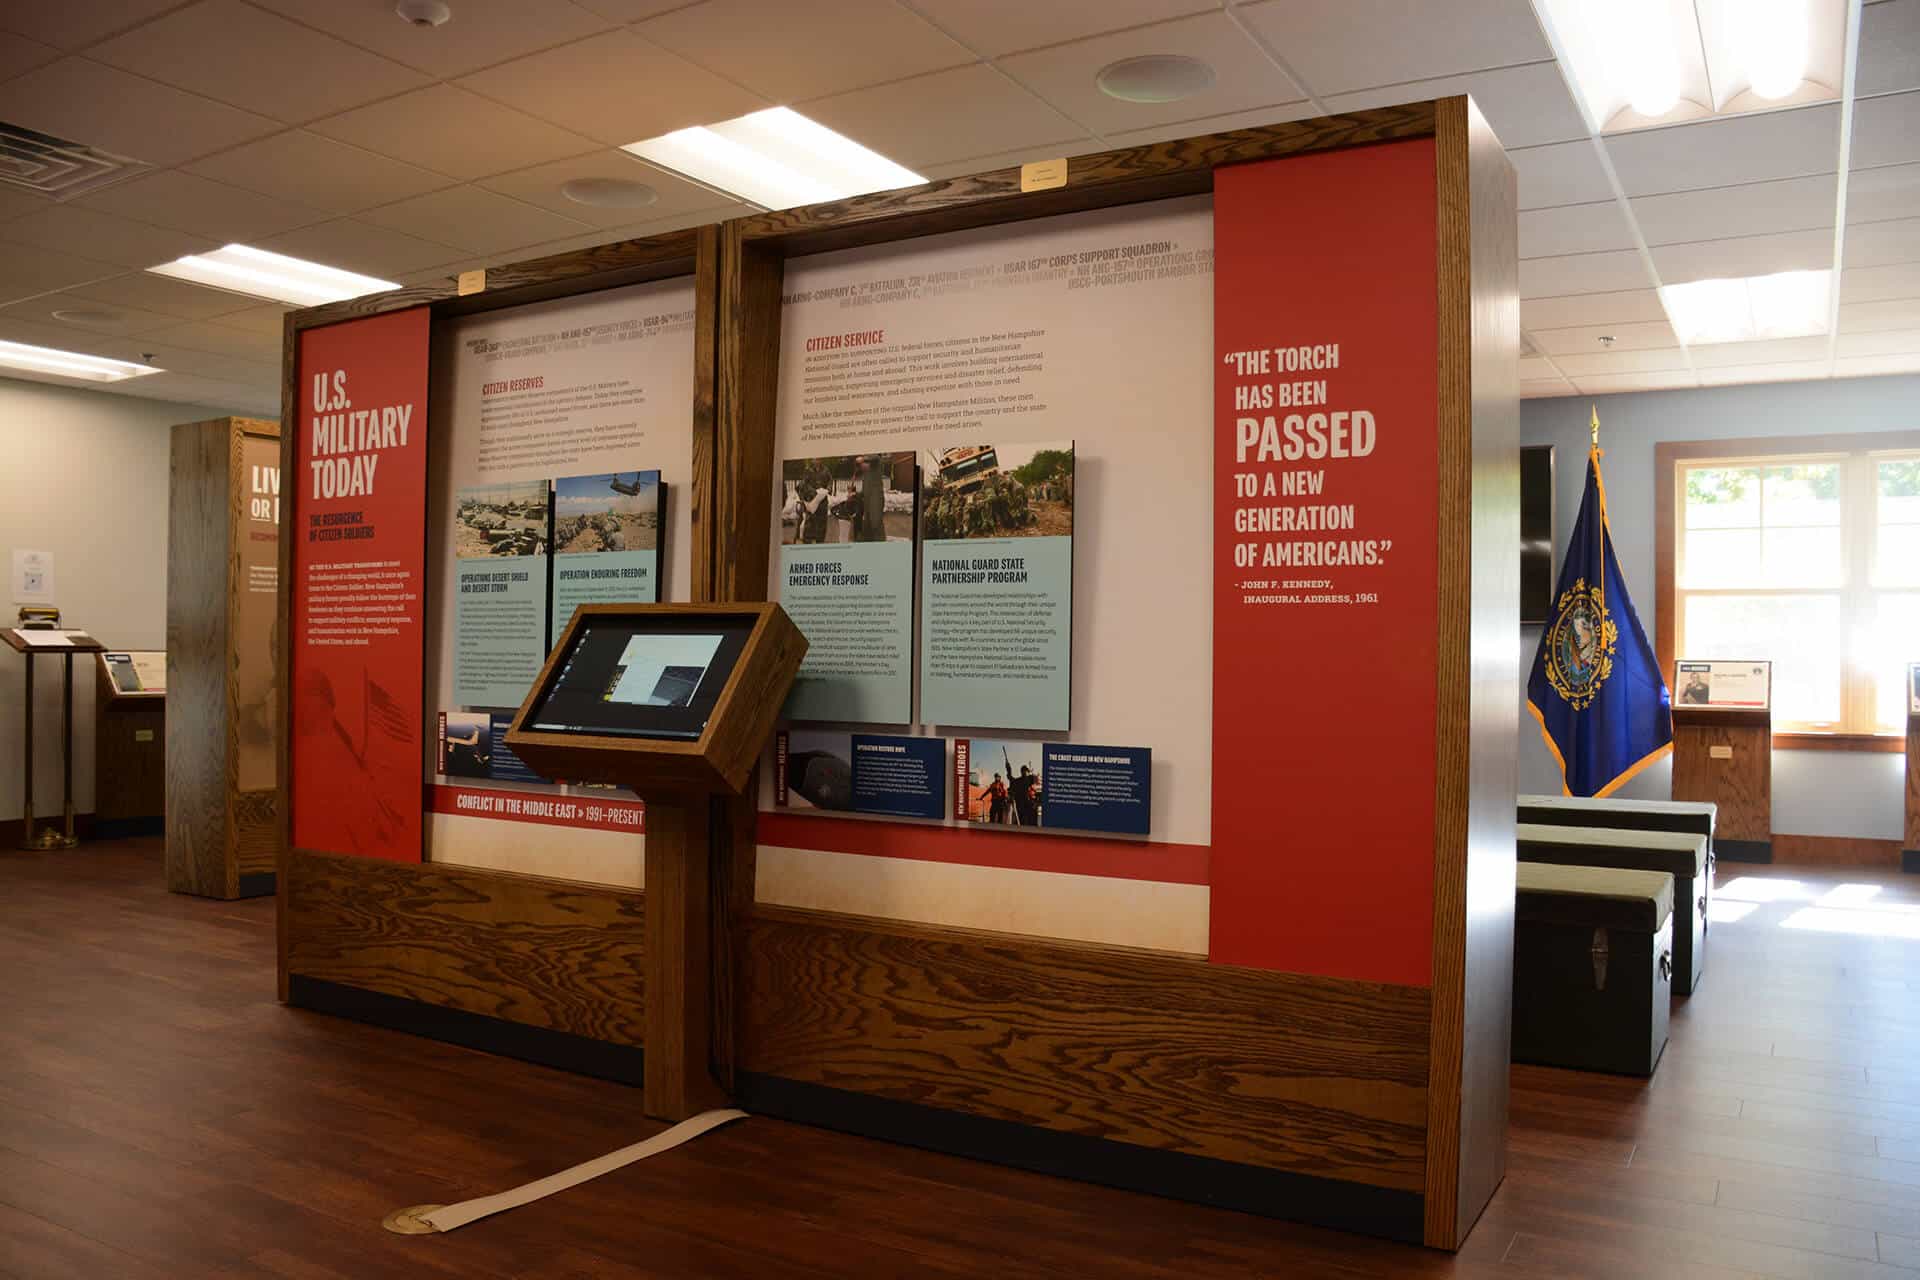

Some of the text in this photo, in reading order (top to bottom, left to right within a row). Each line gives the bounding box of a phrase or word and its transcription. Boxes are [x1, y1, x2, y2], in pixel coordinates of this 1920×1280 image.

[1003, 260, 1026, 273] USAR
[1049, 253, 1078, 267] CORPS
[1079, 247, 1120, 264] SUPPORT
[1121, 241, 1171, 260] SQUADRON
[1137, 251, 1193, 269] OPERATIONS
[1068, 270, 1156, 289] USCG-PORTSMOUTH
[1157, 263, 1196, 278] HARBOR
[807, 330, 884, 352] CITIZEN SERVICE
[1275, 344, 1340, 372] TORCH
[313, 369, 351, 414] U.S.
[483, 375, 544, 396] CITIZEN RESERVES
[1235, 380, 1327, 410] HAS BEEN
[312, 404, 413, 456] MILITARY
[1236, 411, 1377, 463] PASSED
[311, 455, 378, 500] TODAY
[1234, 470, 1325, 498] TO A NEW
[251, 497, 271, 519] OR
[1234, 504, 1355, 533] GENERATION
[932, 558, 1025, 572] NATIONAL GUARD STATE
[1234, 539, 1393, 568] OF AMERICANS.”
[461, 572, 528, 583] OPERATIONS DESERT SHIELD
[560, 567, 648, 580] OPERATION ENDURING FREEDOM
[789, 562, 842, 575] ARMED FORCES
[932, 570, 1028, 585] PARTNERSHIP PROGRAM
[461, 583, 508, 593] AND DESERT STORM
[789, 574, 869, 587] EMERGENCY RESPONSE
[1241, 580, 1269, 589] JOHN
[1271, 580, 1281, 589] F.
[1282, 580, 1334, 591] KENNEDY,
[1244, 593, 1379, 605] INAUGURAL ADDRESS, 1961
[957, 745, 966, 775] HEROES
[457, 794, 495, 812] CONFLICT
[496, 797, 505, 811] IN
[506, 798, 521, 814] THE
[523, 799, 553, 817] MIDDLE
[555, 801, 577, 818] EAST
